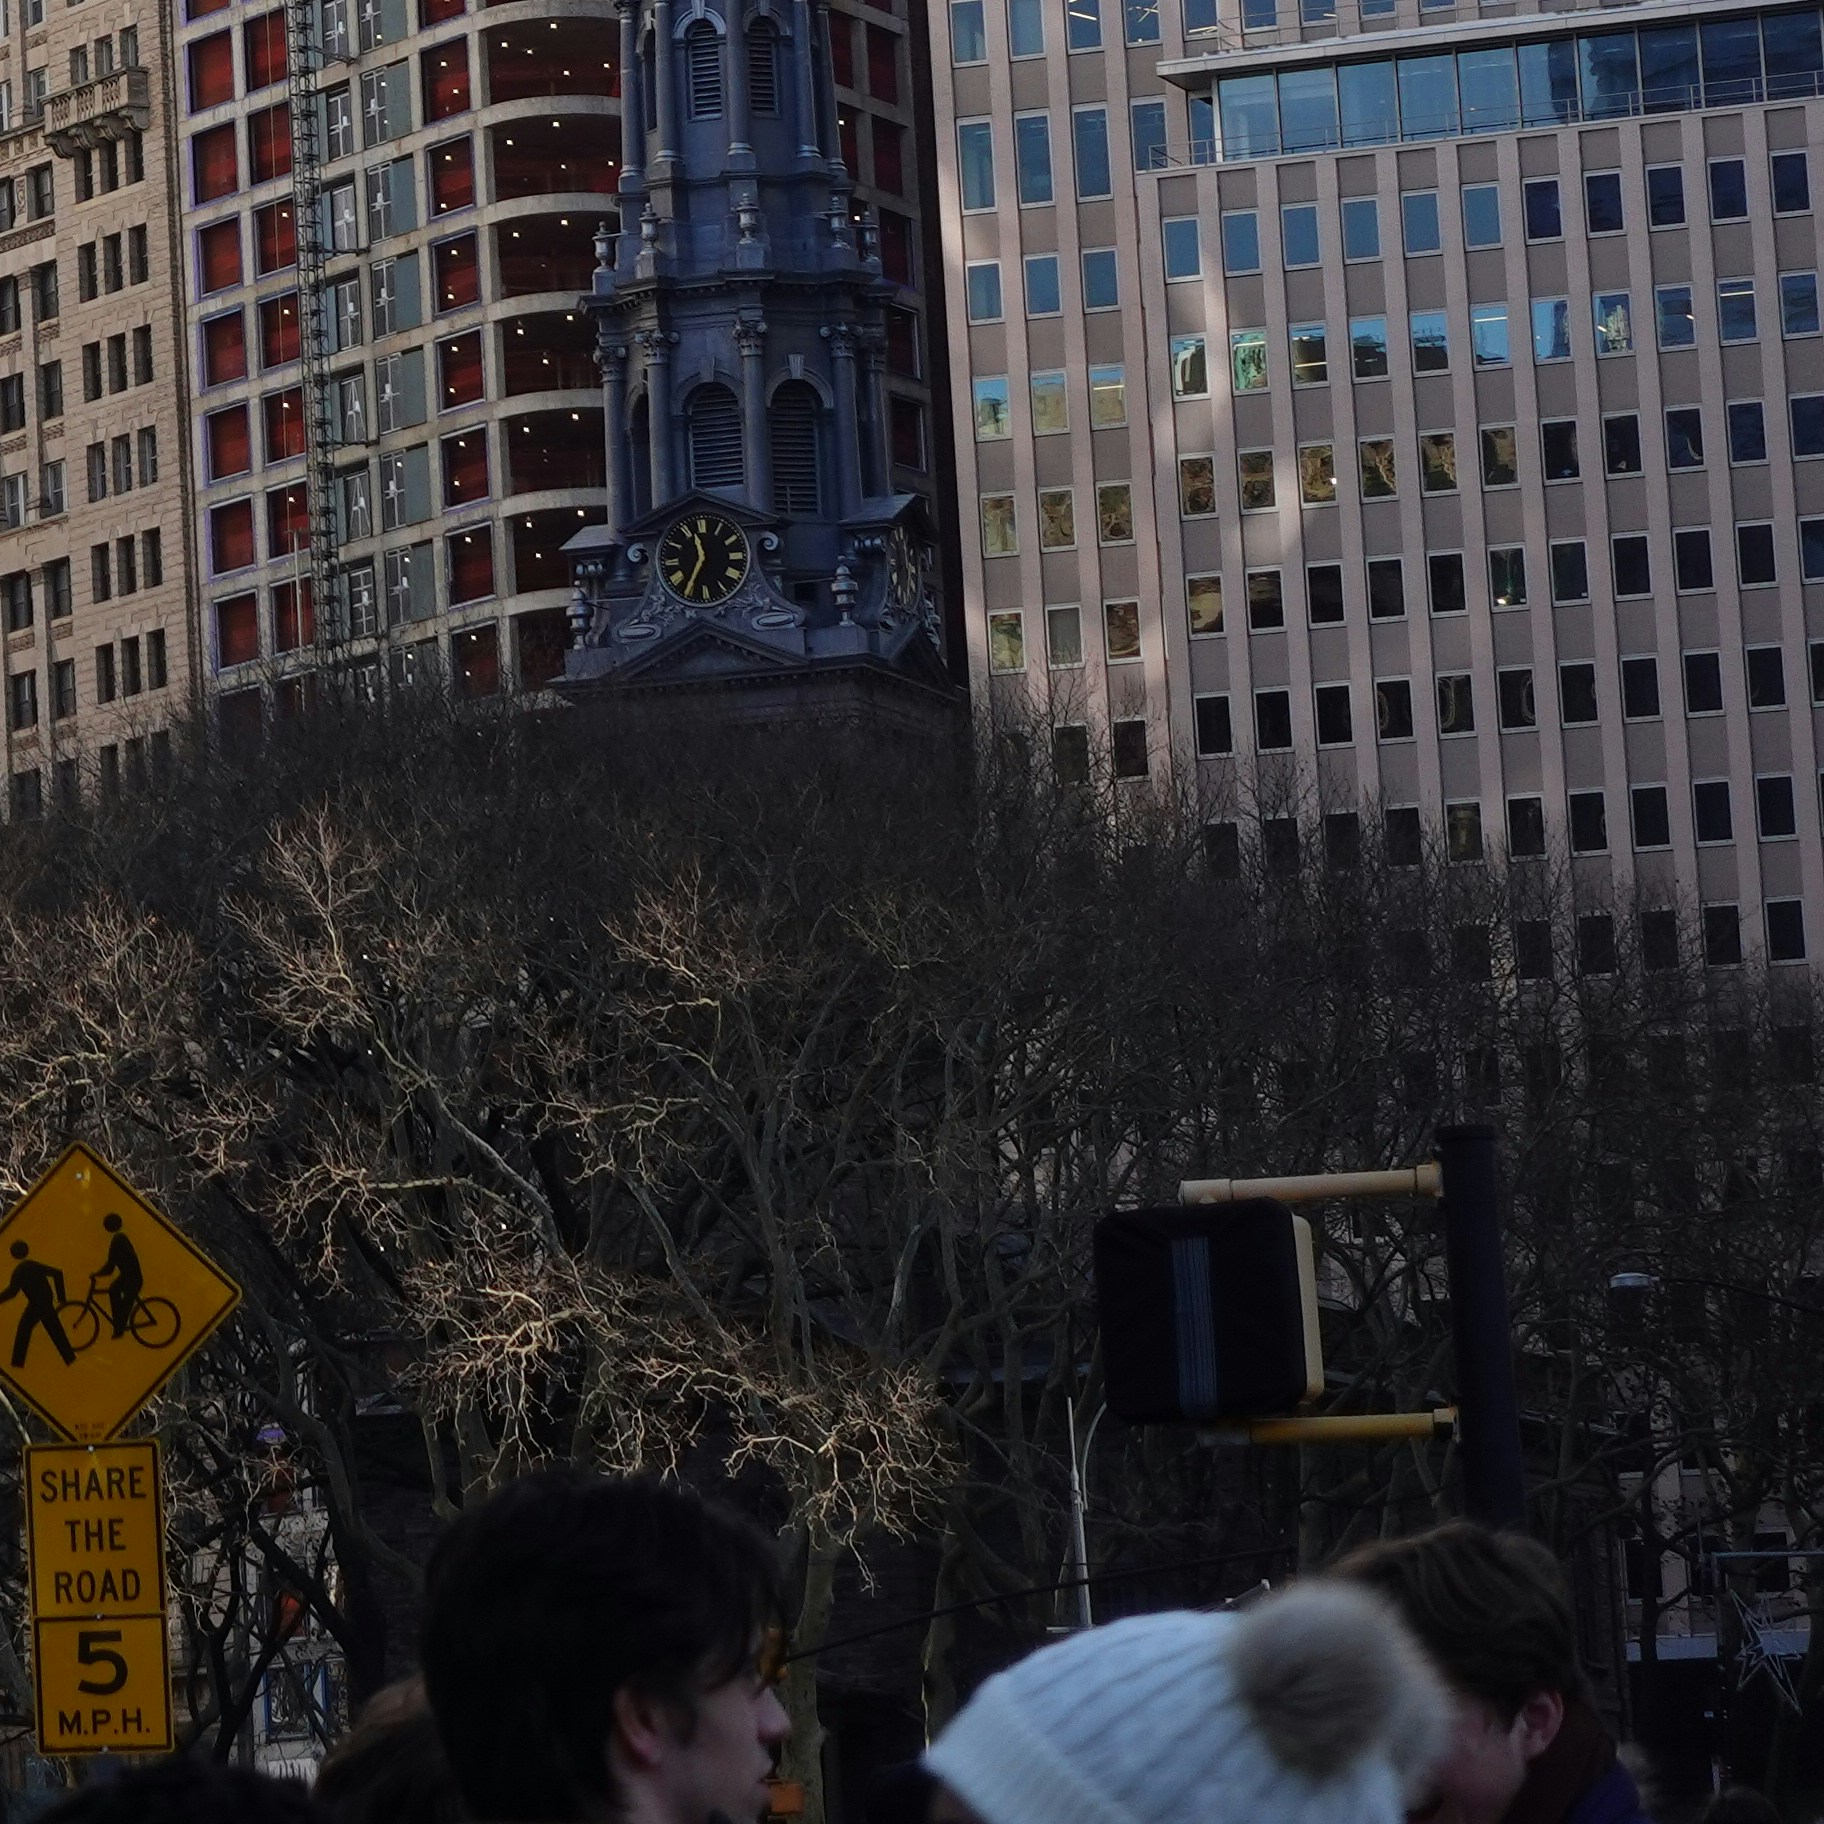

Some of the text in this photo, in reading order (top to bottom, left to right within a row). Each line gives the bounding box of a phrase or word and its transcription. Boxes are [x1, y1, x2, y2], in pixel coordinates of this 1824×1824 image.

[40, 1465, 147, 1503] SHARE
[64, 1518, 127, 1553] THE
[53, 1568, 141, 1604] ROAD
[77, 1630, 129, 1696] 5
[58, 1707, 151, 1736] M.P.H.
